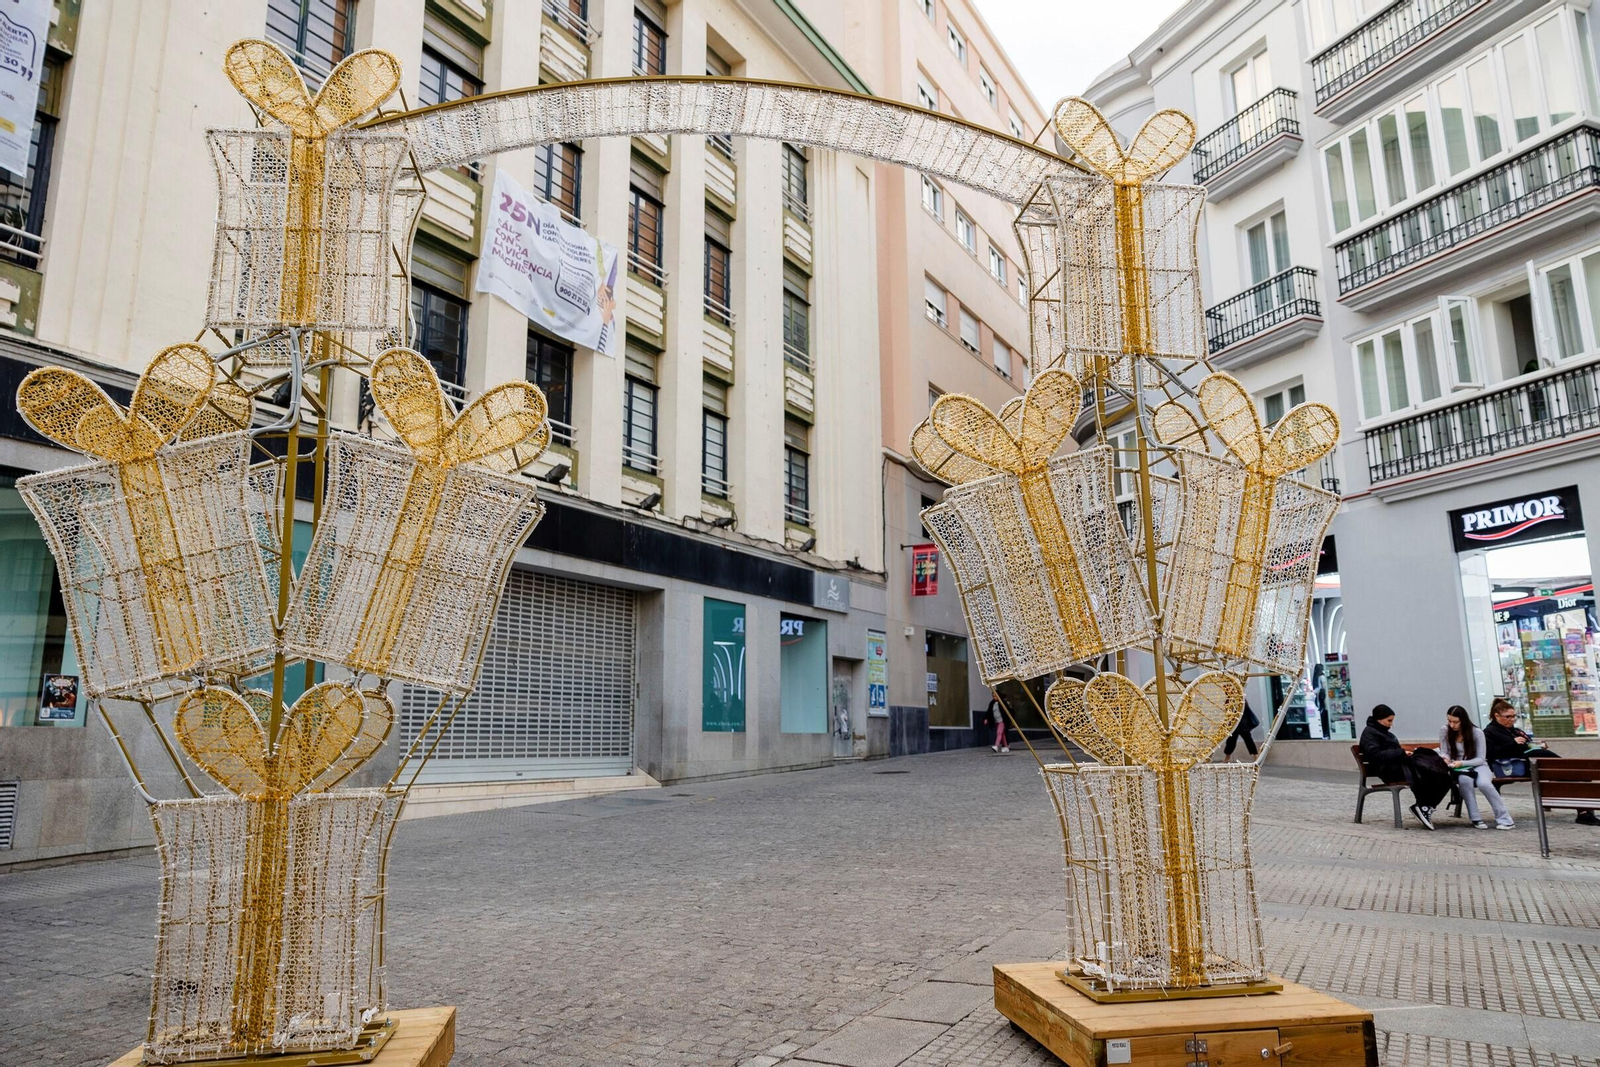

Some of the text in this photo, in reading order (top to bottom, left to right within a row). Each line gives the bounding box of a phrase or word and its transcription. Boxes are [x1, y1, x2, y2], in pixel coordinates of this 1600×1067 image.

[4, 55, 18, 66] 30
[500, 192, 540, 236] 25N
[492, 247, 532, 282] MACHISA
[506, 246, 552, 280] VIOENCIA
[560, 286, 572, 297] 900
[1462, 496, 1564, 532] PRIMOR
[1558, 598, 1577, 610] Dior
